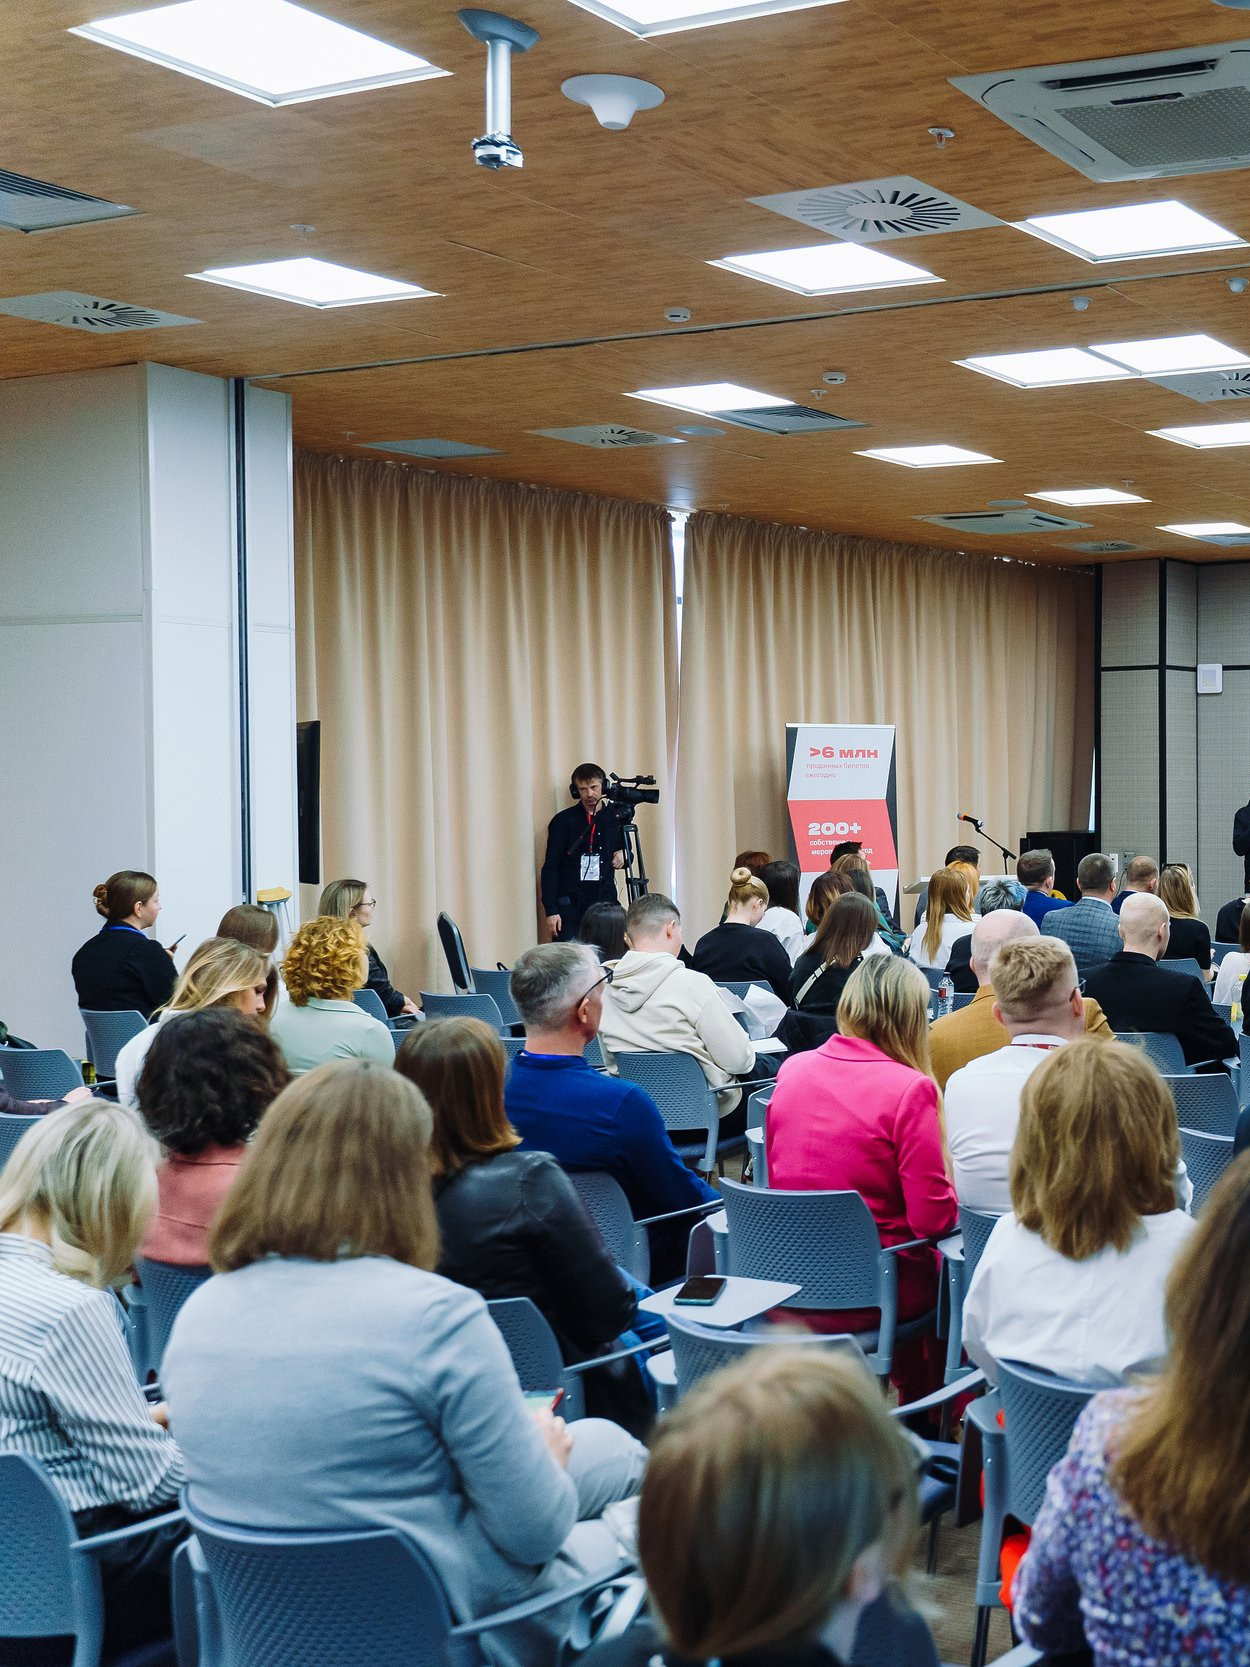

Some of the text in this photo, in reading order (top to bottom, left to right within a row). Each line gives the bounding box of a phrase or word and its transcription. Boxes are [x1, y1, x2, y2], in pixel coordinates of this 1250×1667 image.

[809, 746, 835, 758] >6
[806, 761, 870, 770] проданных билетов
[807, 821, 862, 836] 200+
